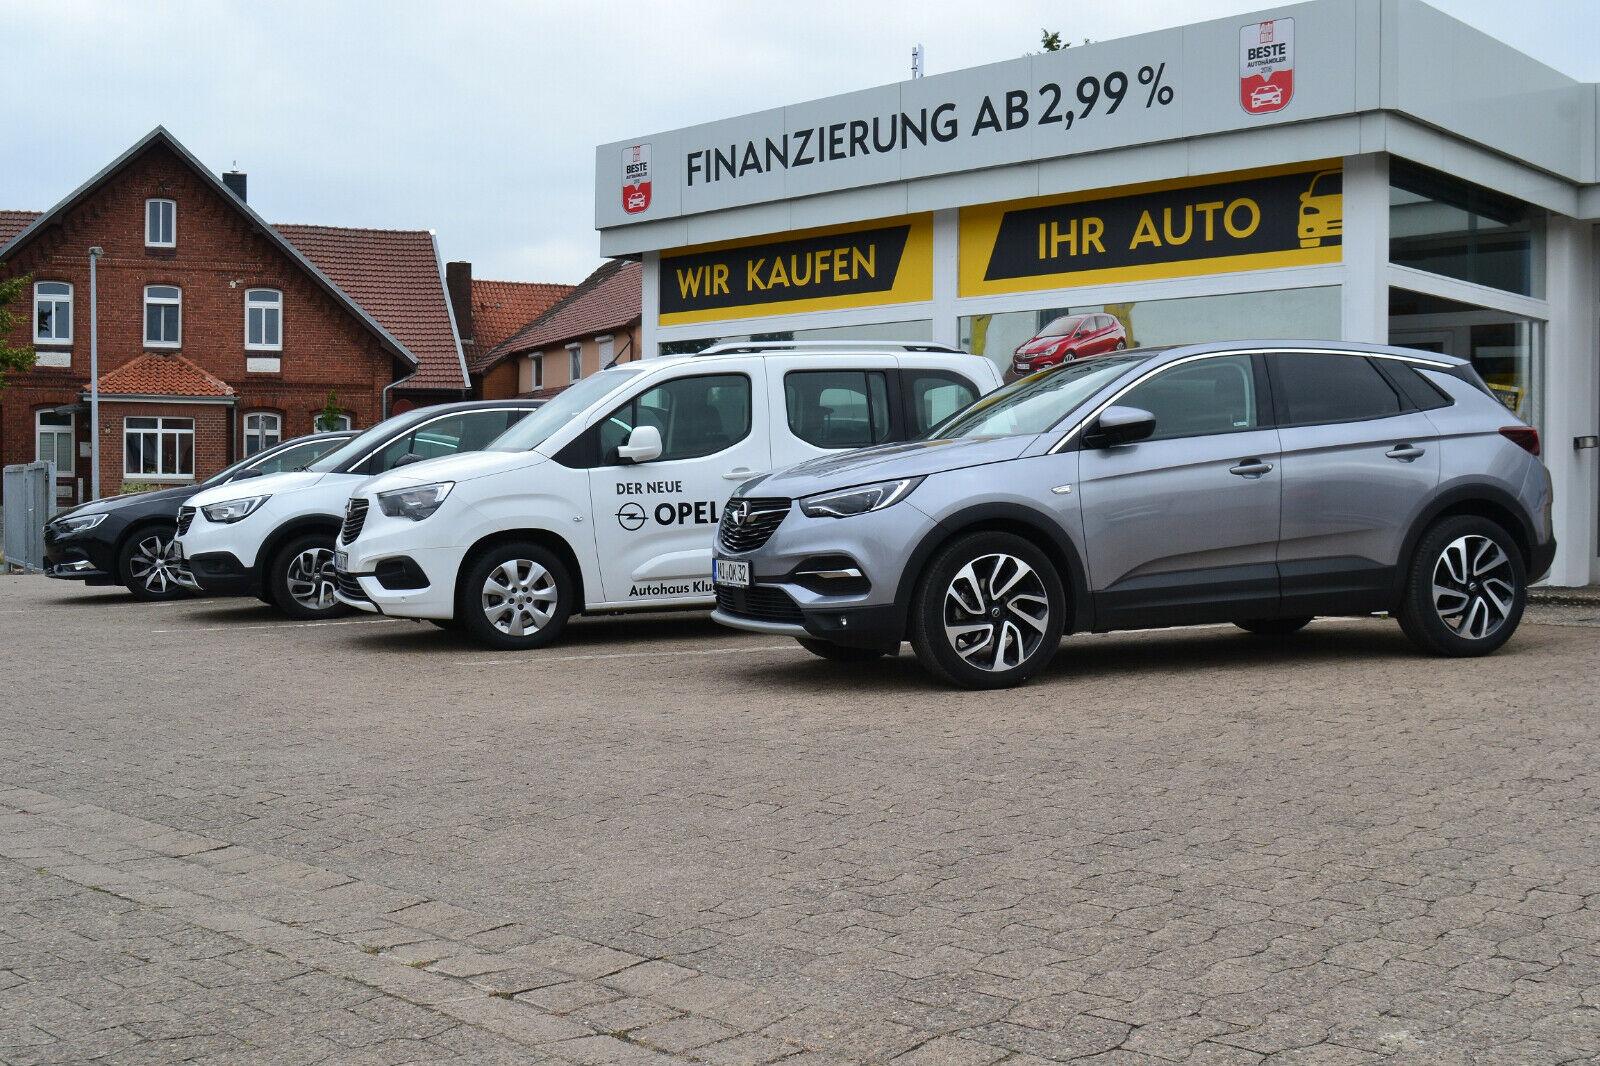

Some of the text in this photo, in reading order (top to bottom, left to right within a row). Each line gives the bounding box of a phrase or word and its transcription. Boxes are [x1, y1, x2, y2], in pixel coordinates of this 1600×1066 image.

[1248, 43, 1286, 60] BESTE
[687, 62, 1174, 187] FINANZIERUNG AB 2,99 %
[626, 162, 647, 174] BESTE
[1038, 197, 1260, 260] IHR AUTO
[676, 243, 876, 299] WIR KAUFEN
[616, 480, 682, 495] DER NEUE
[654, 501, 719, 526] OPEL
[629, 580, 716, 597] Autohaus Klu
